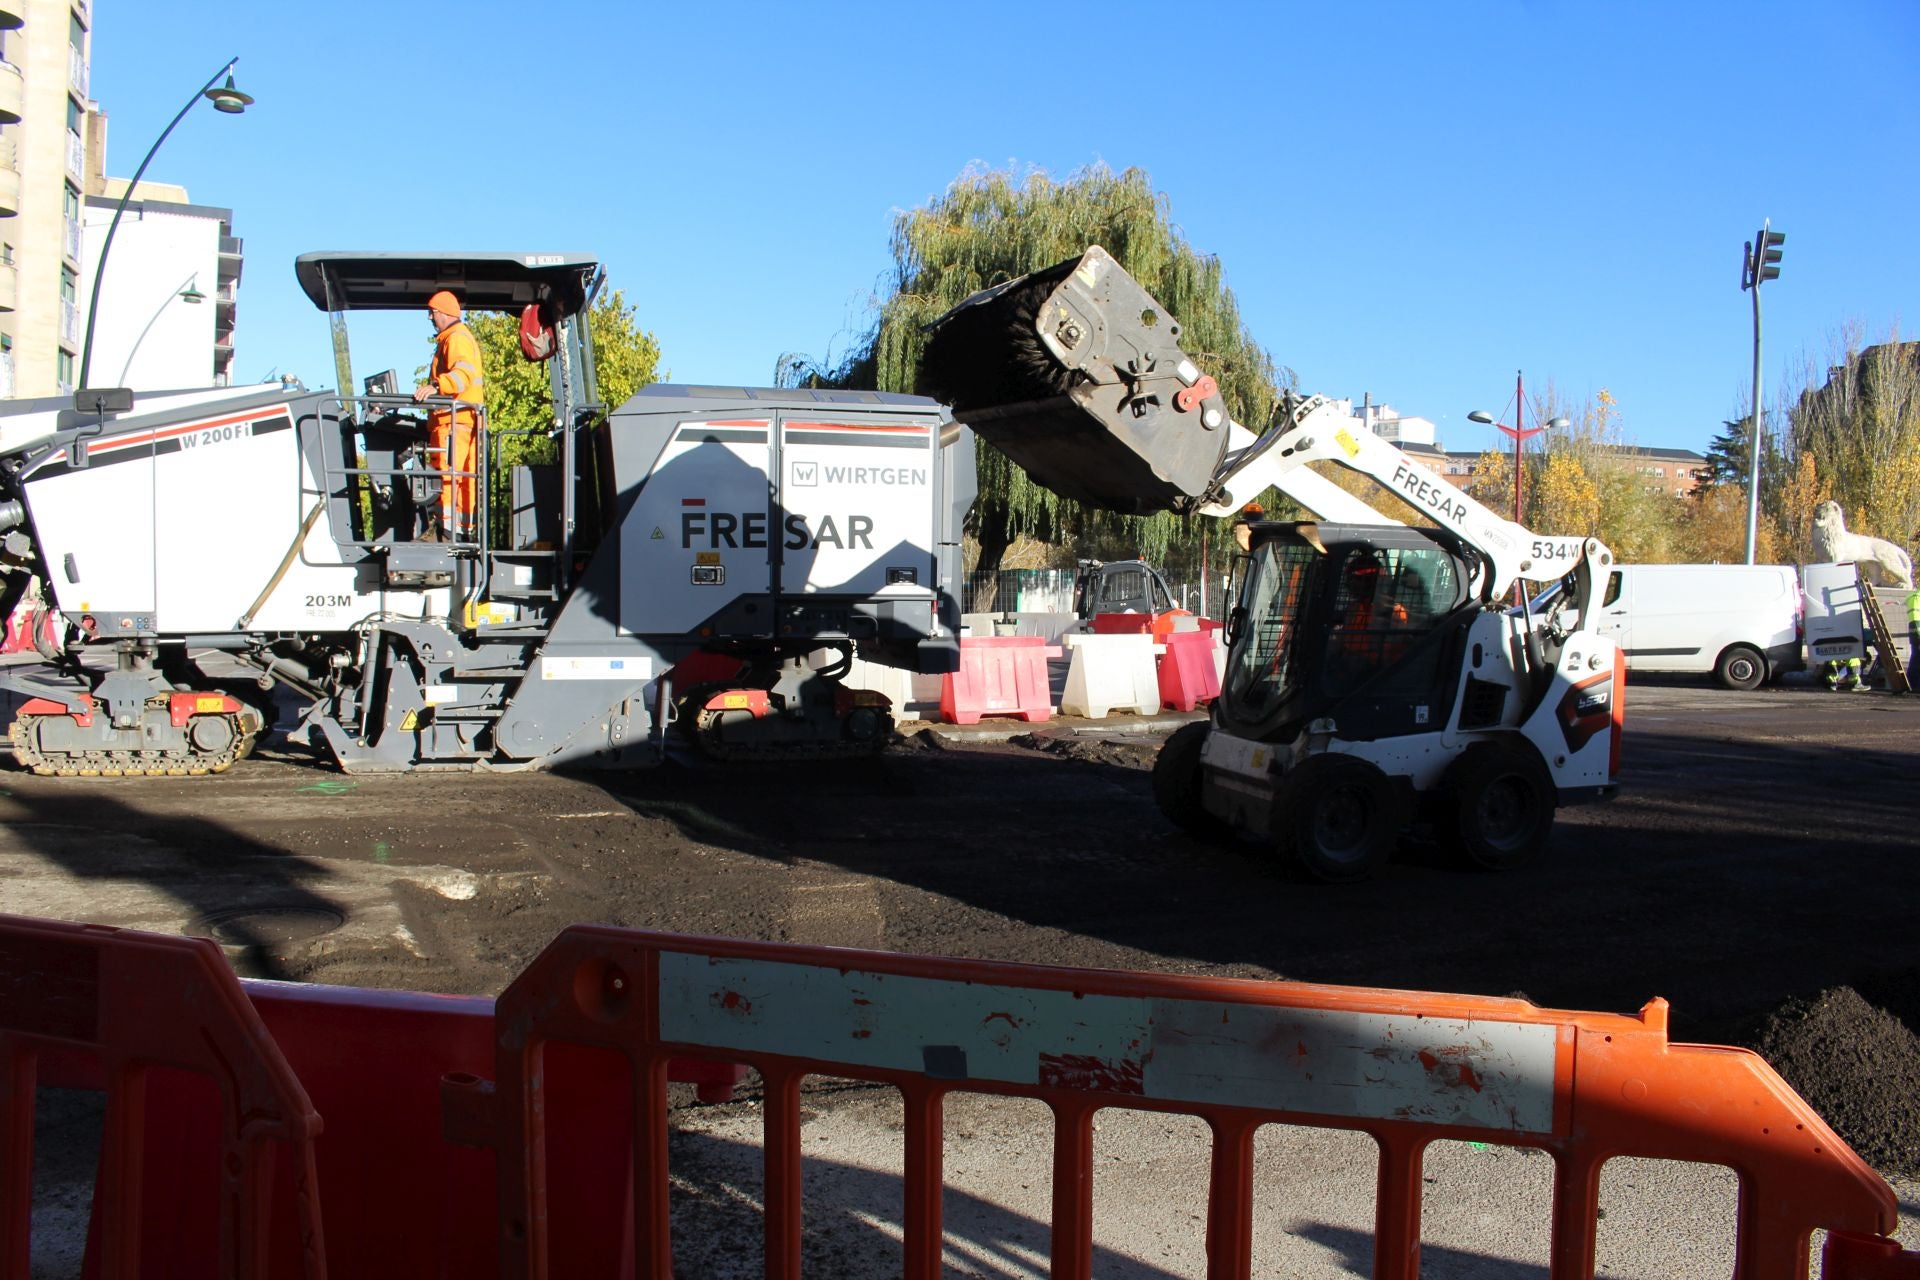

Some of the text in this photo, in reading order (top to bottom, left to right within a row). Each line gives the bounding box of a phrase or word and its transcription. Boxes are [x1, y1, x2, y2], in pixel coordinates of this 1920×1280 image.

[825, 466, 926, 486] WIRTGEN
[1392, 465, 1467, 524] FRESAR
[681, 512, 874, 551] FRESAR
[305, 595, 351, 607] 203M
